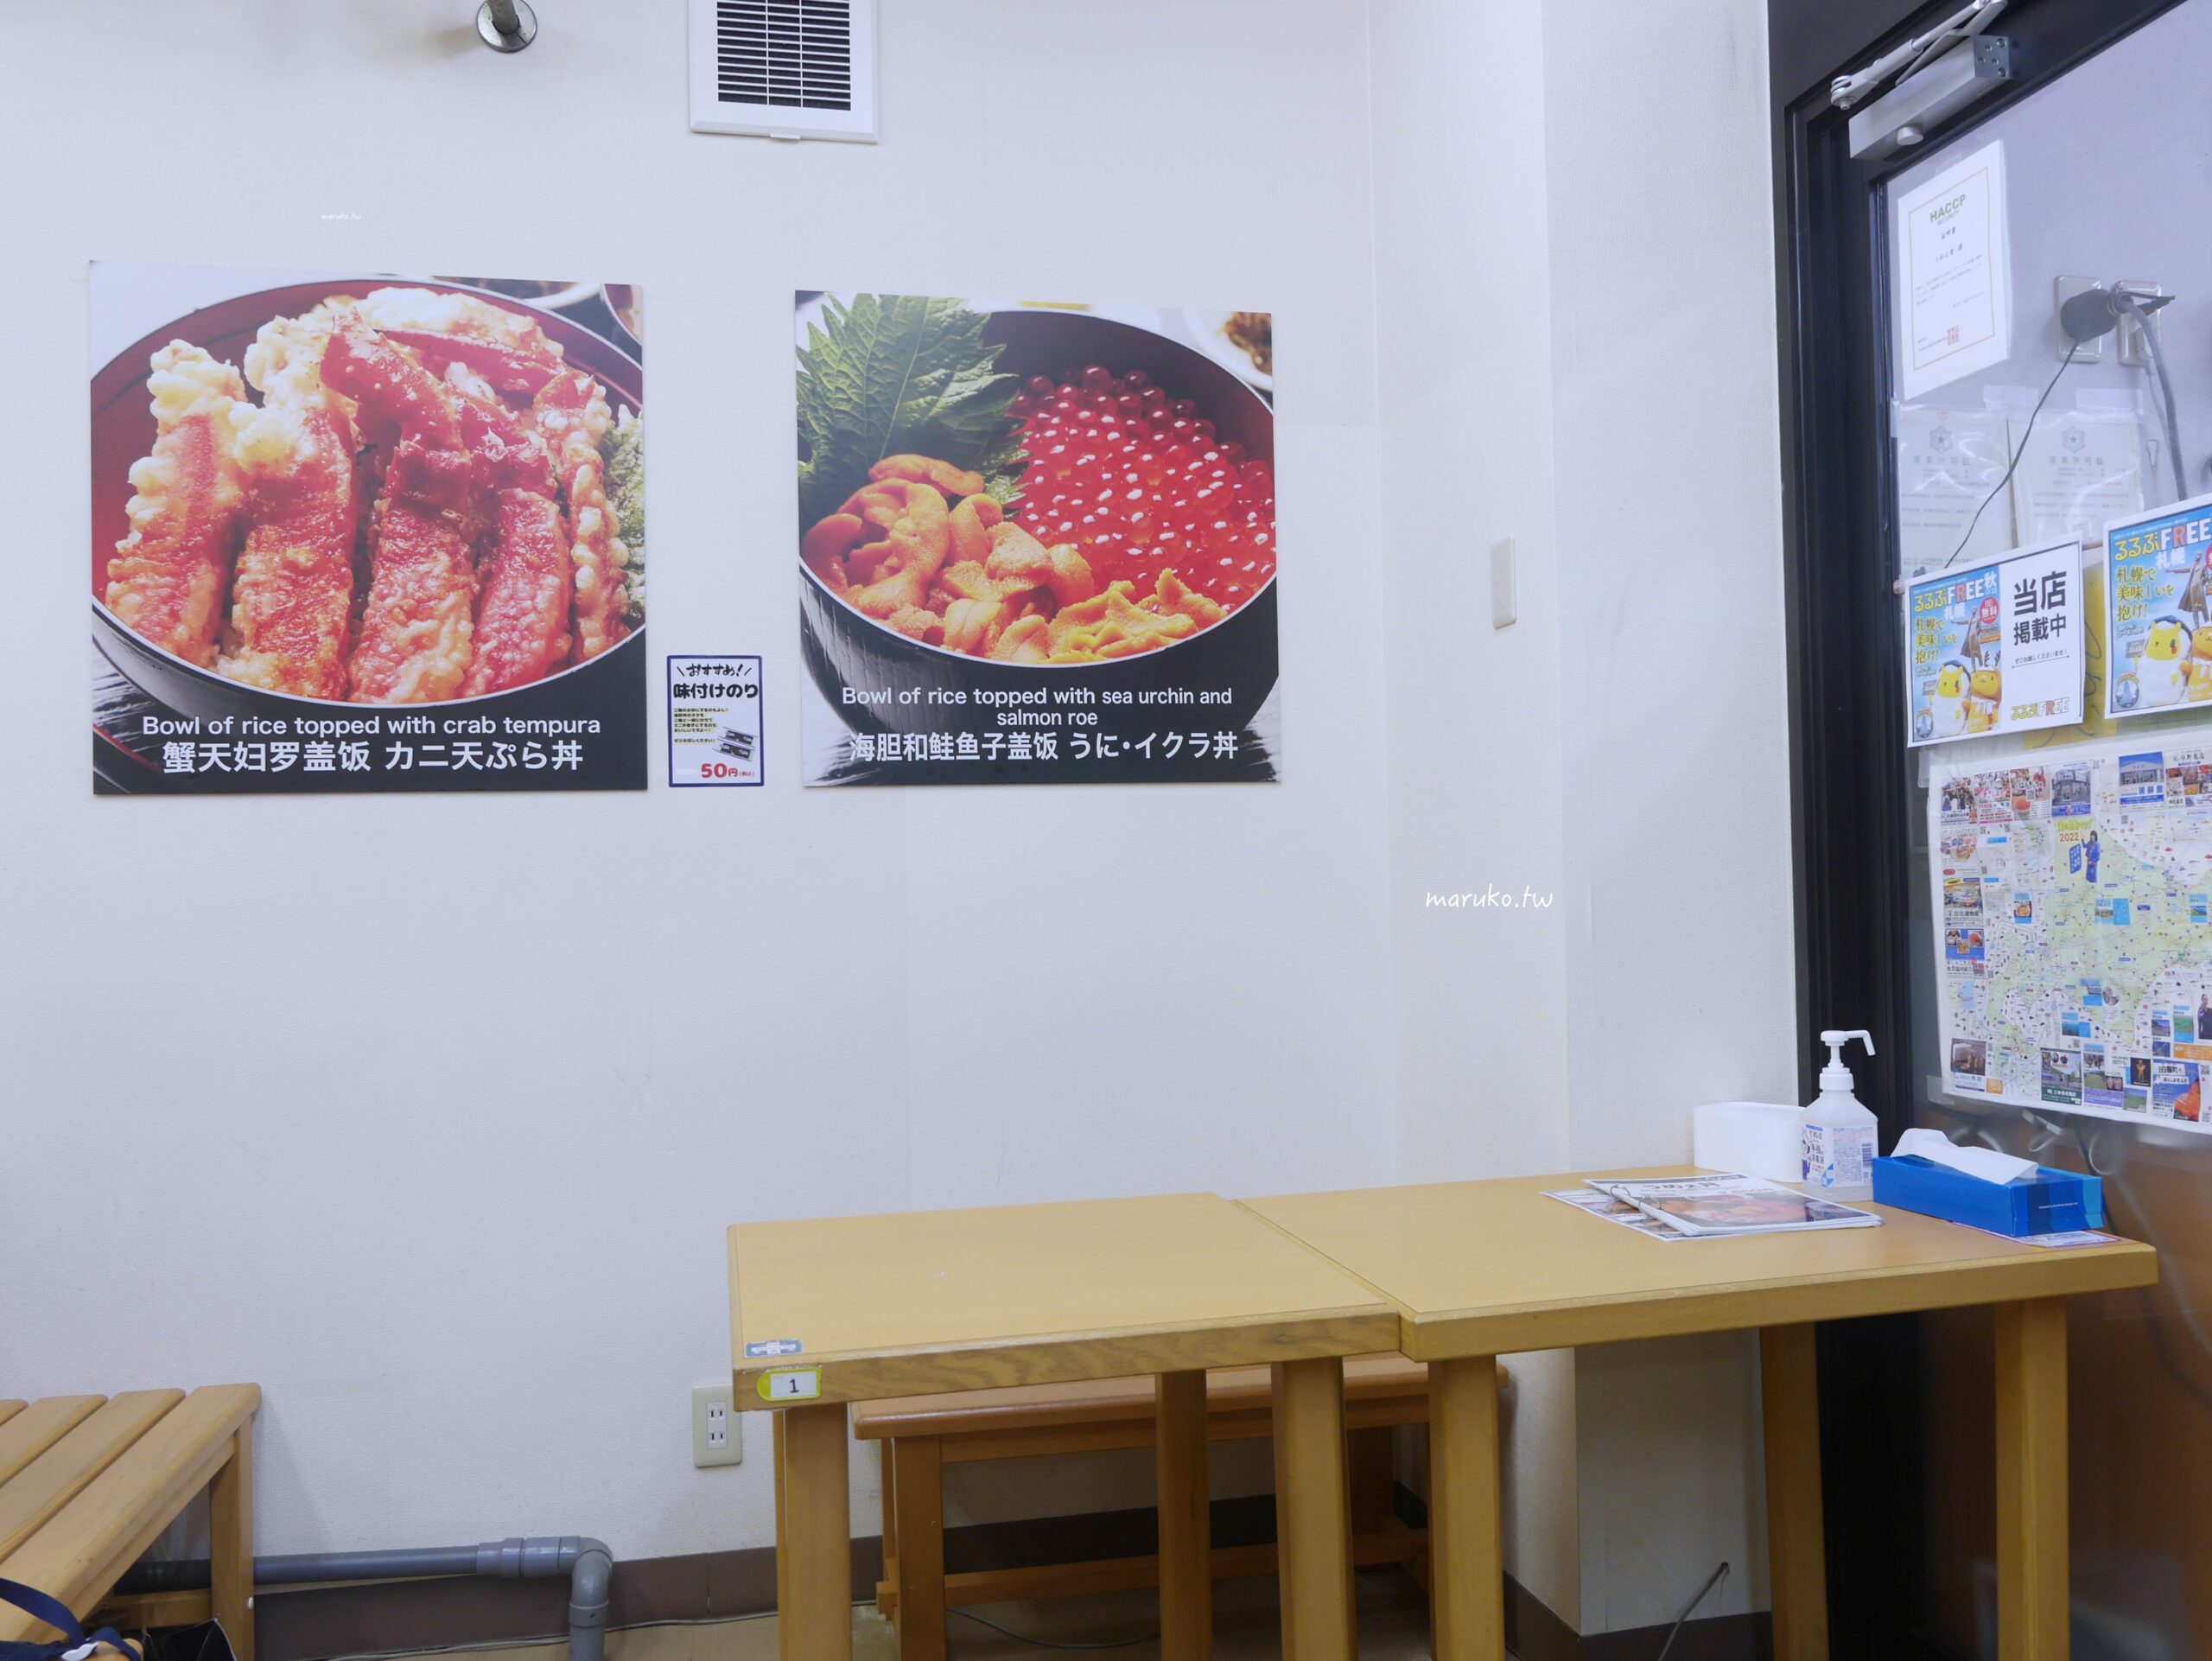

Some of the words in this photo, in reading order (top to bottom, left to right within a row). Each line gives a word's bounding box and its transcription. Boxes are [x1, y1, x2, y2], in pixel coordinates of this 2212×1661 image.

[1929, 194, 1967, 223] HACCP
[2013, 570, 2067, 616] 当店
[2013, 613, 2067, 646] 掲載中
[673, 683, 759, 698] 味付けのり
[843, 688, 891, 704] Bowl
[899, 687, 921, 704] of
[929, 688, 967, 704] rice
[974, 688, 1047, 709] topped
[1054, 688, 1096, 704] with
[1103, 692, 1133, 704] sea
[1139, 688, 1194, 704] urchin
[1200, 688, 1232, 704] and
[143, 716, 200, 735] Bowl
[208, 716, 233, 735] of
[242, 716, 287, 735] rice
[295, 716, 379, 738] topped
[388, 716, 435, 734] with
[444, 716, 496, 734] crab
[503, 717, 601, 738] tempura
[997, 710, 1061, 725] salmon
[1068, 713, 1097, 725] roe
[162, 741, 372, 773] 蟹天妇罗盖饭
[385, 741, 583, 771] カニ天ぷら丼
[849, 732, 1058, 761] 海胆和鲑鱼子盖饭
[1070, 732, 1238, 760] うに・イクラ丼
[2059, 832, 2080, 843] 2022
[789, 1378, 799, 1394] 1
